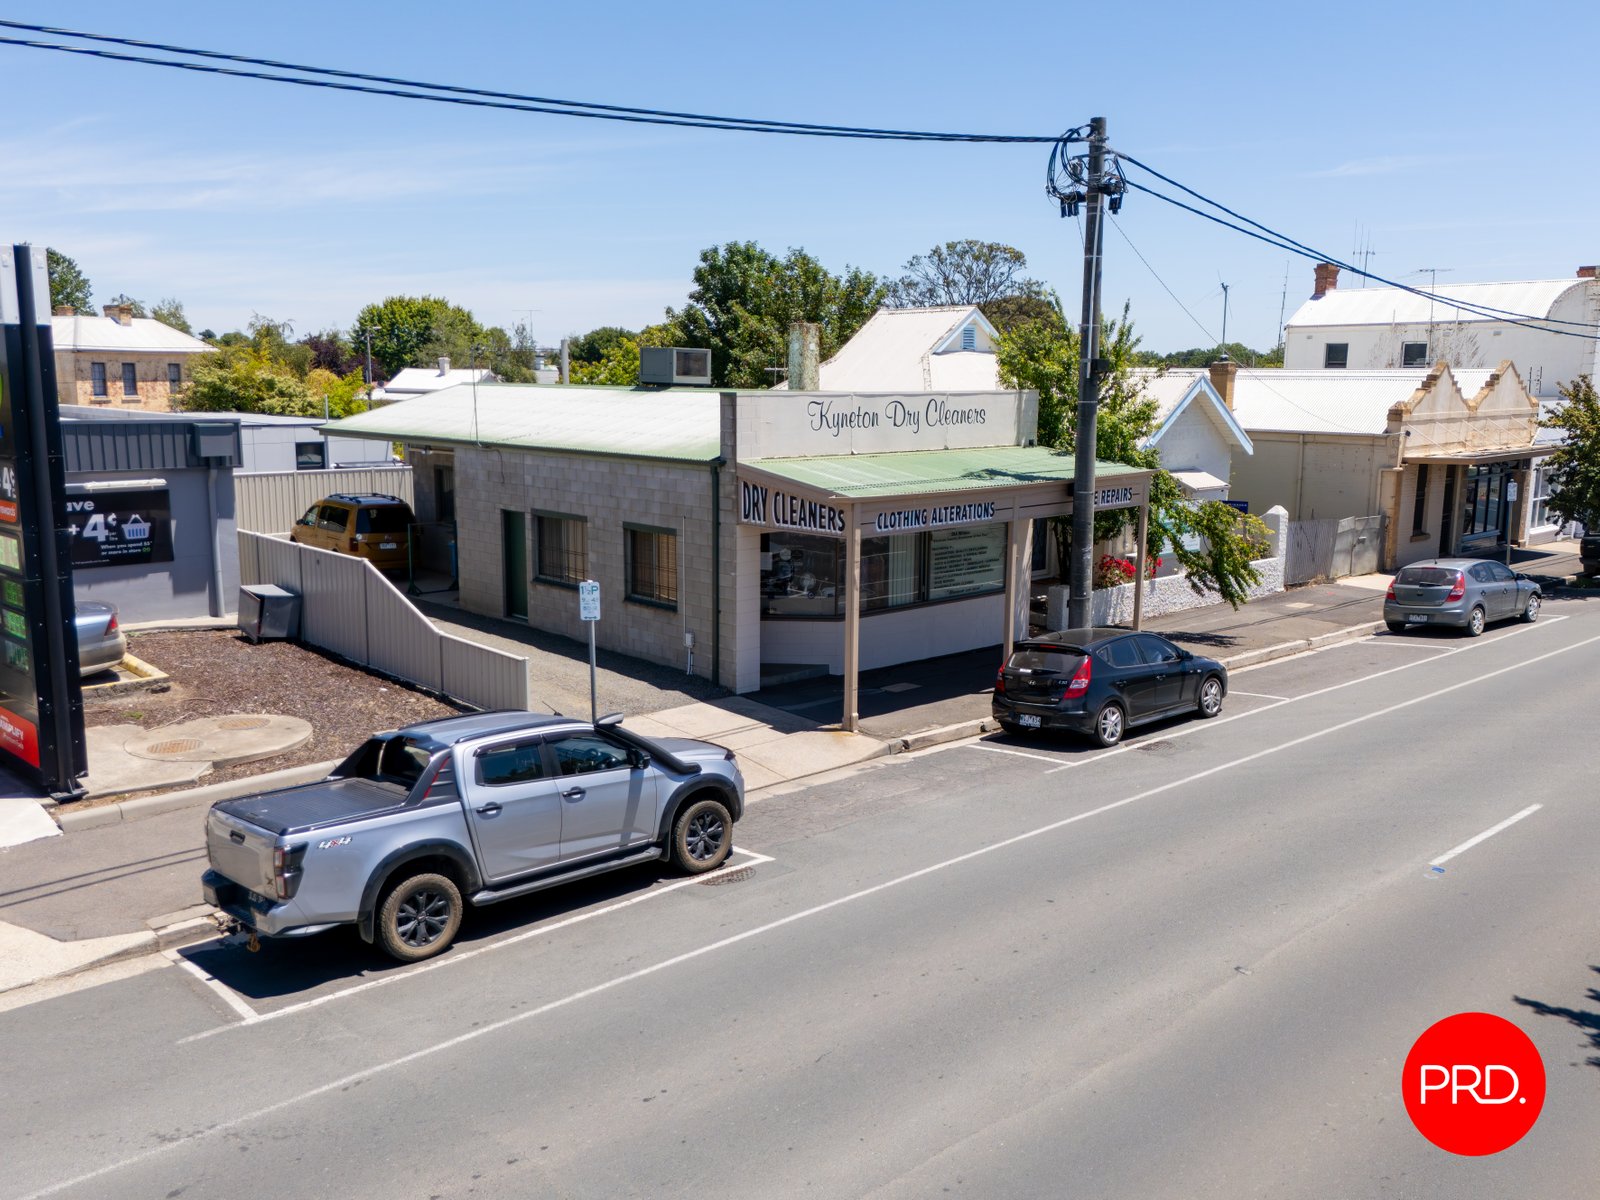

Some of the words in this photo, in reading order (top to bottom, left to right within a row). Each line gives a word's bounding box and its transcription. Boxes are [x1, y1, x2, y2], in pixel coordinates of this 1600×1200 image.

[807, 401, 879, 437] Kyneton
[885, 400, 920, 434] Dry
[925, 398, 986, 427] Cleaners
[742, 481, 768, 523] DRY
[772, 491, 845, 533] CLEANERS
[1100, 487, 1133, 505] REPAIRS
[876, 509, 927, 531] CLOTHING
[930, 501, 995, 525] ALTERATIONS
